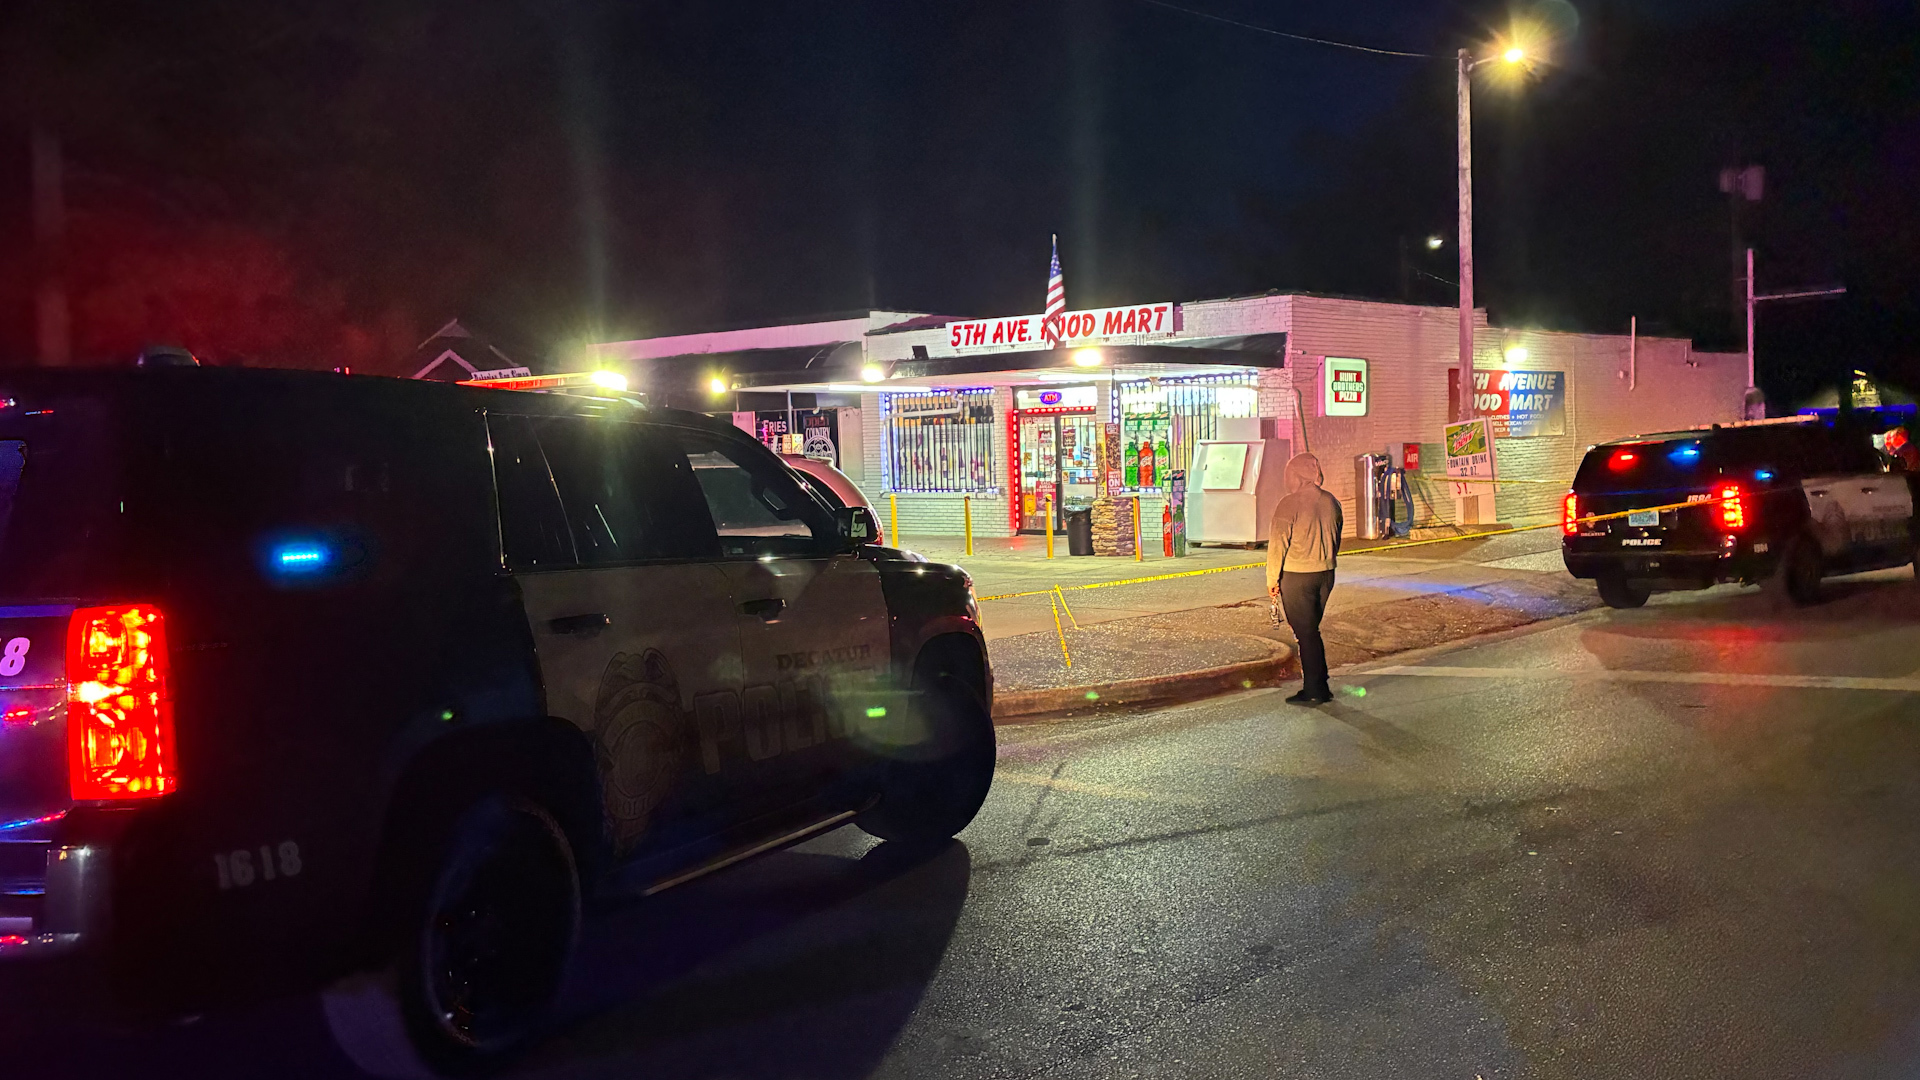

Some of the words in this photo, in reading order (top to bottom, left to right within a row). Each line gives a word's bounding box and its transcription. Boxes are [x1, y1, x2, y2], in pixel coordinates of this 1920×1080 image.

[951, 323, 987, 347] 5TH
[992, 319, 1032, 344] AVE.
[1103, 306, 1168, 336] MART
[1339, 372, 1358, 381] HUNT
[1499, 372, 1557, 391] AVENUE
[1332, 381, 1364, 391] BROTHERS
[1043, 394, 1058, 402] ATM
[1339, 391, 1358, 401] PIZZA
[1510, 393, 1554, 412] MART
[762, 420, 787, 432] FRIES
[805, 426, 831, 440] COUNTRY
[1406, 453, 1418, 463] AIR
[1447, 456, 1469, 469] FOUNTAIN
[1472, 453, 1487, 465] DRINK
[1460, 467, 1468, 477] 32
[1622, 538, 1663, 547] POLICE
[0, 637, 31, 676] 8
[775, 643, 871, 670] DECATUR
[213, 840, 303, 891] 1618
